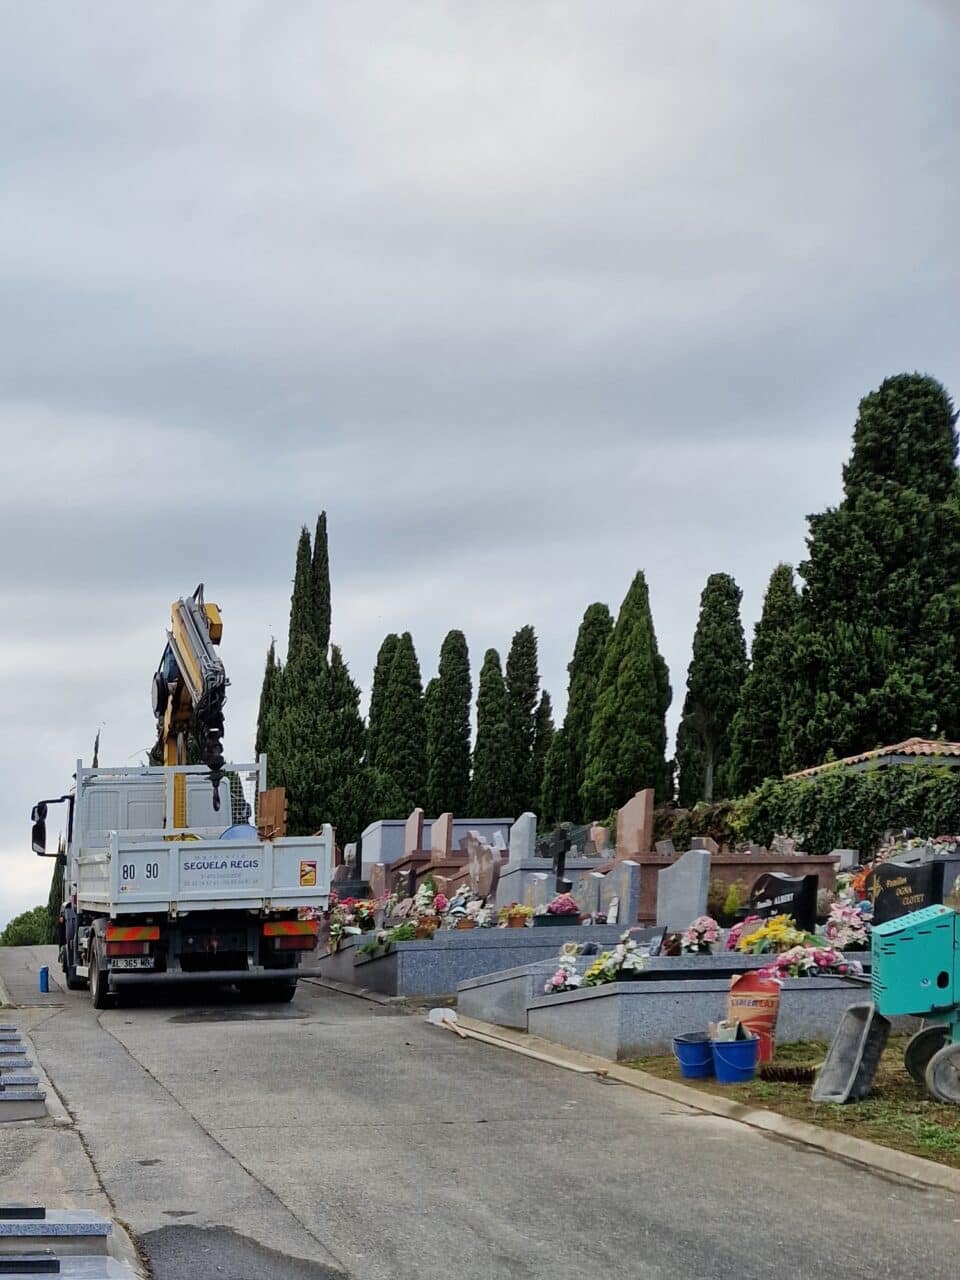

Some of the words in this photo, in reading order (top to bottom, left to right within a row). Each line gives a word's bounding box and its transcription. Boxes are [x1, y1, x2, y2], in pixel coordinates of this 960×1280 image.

[183, 861, 228, 871] SEGUELA
[230, 859, 259, 869] REGIS
[122, 864, 136, 880] 80
[145, 863, 159, 879] 90
[902, 894, 925, 906] CLOTET
[124, 959, 138, 968] 365
